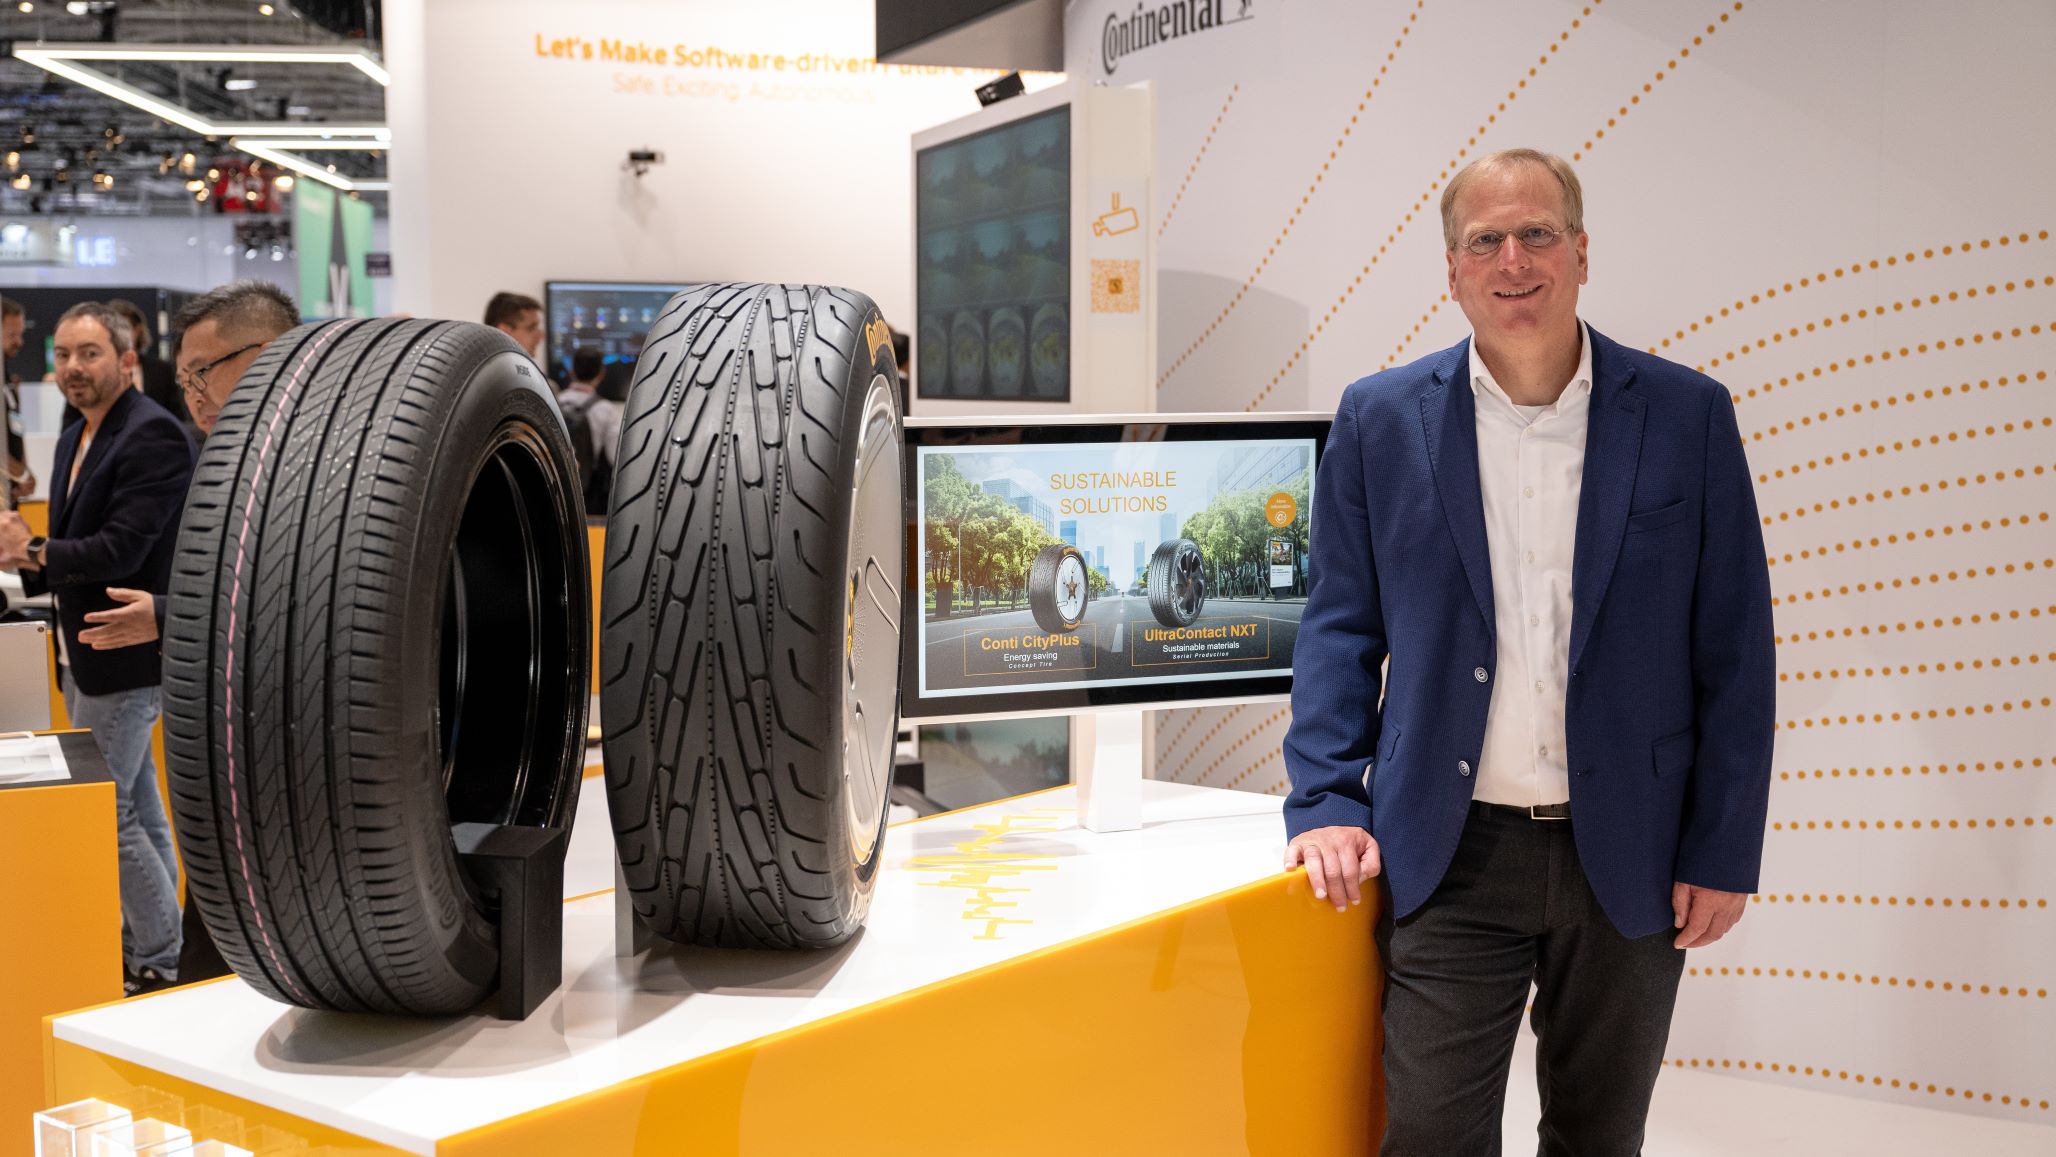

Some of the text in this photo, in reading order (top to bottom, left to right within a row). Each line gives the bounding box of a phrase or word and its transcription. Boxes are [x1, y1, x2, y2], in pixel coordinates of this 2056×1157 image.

[536, 33, 593, 60] Let's
[600, 38, 668, 65] Make
[674, 44, 877, 73] Software-driven
[1049, 470, 1177, 491] SUSTAINABLE
[1059, 495, 1168, 515] SOLUTIONS
[1144, 623, 1258, 642] UltraContact NXT
[981, 633, 1081, 651] Conti CityPlus
[1162, 640, 1240, 654] Sustainable materials
[1003, 651, 1059, 663] Energy saving
[1194, 651, 1230, 659] Production
[1008, 662, 1037, 670] Concept
